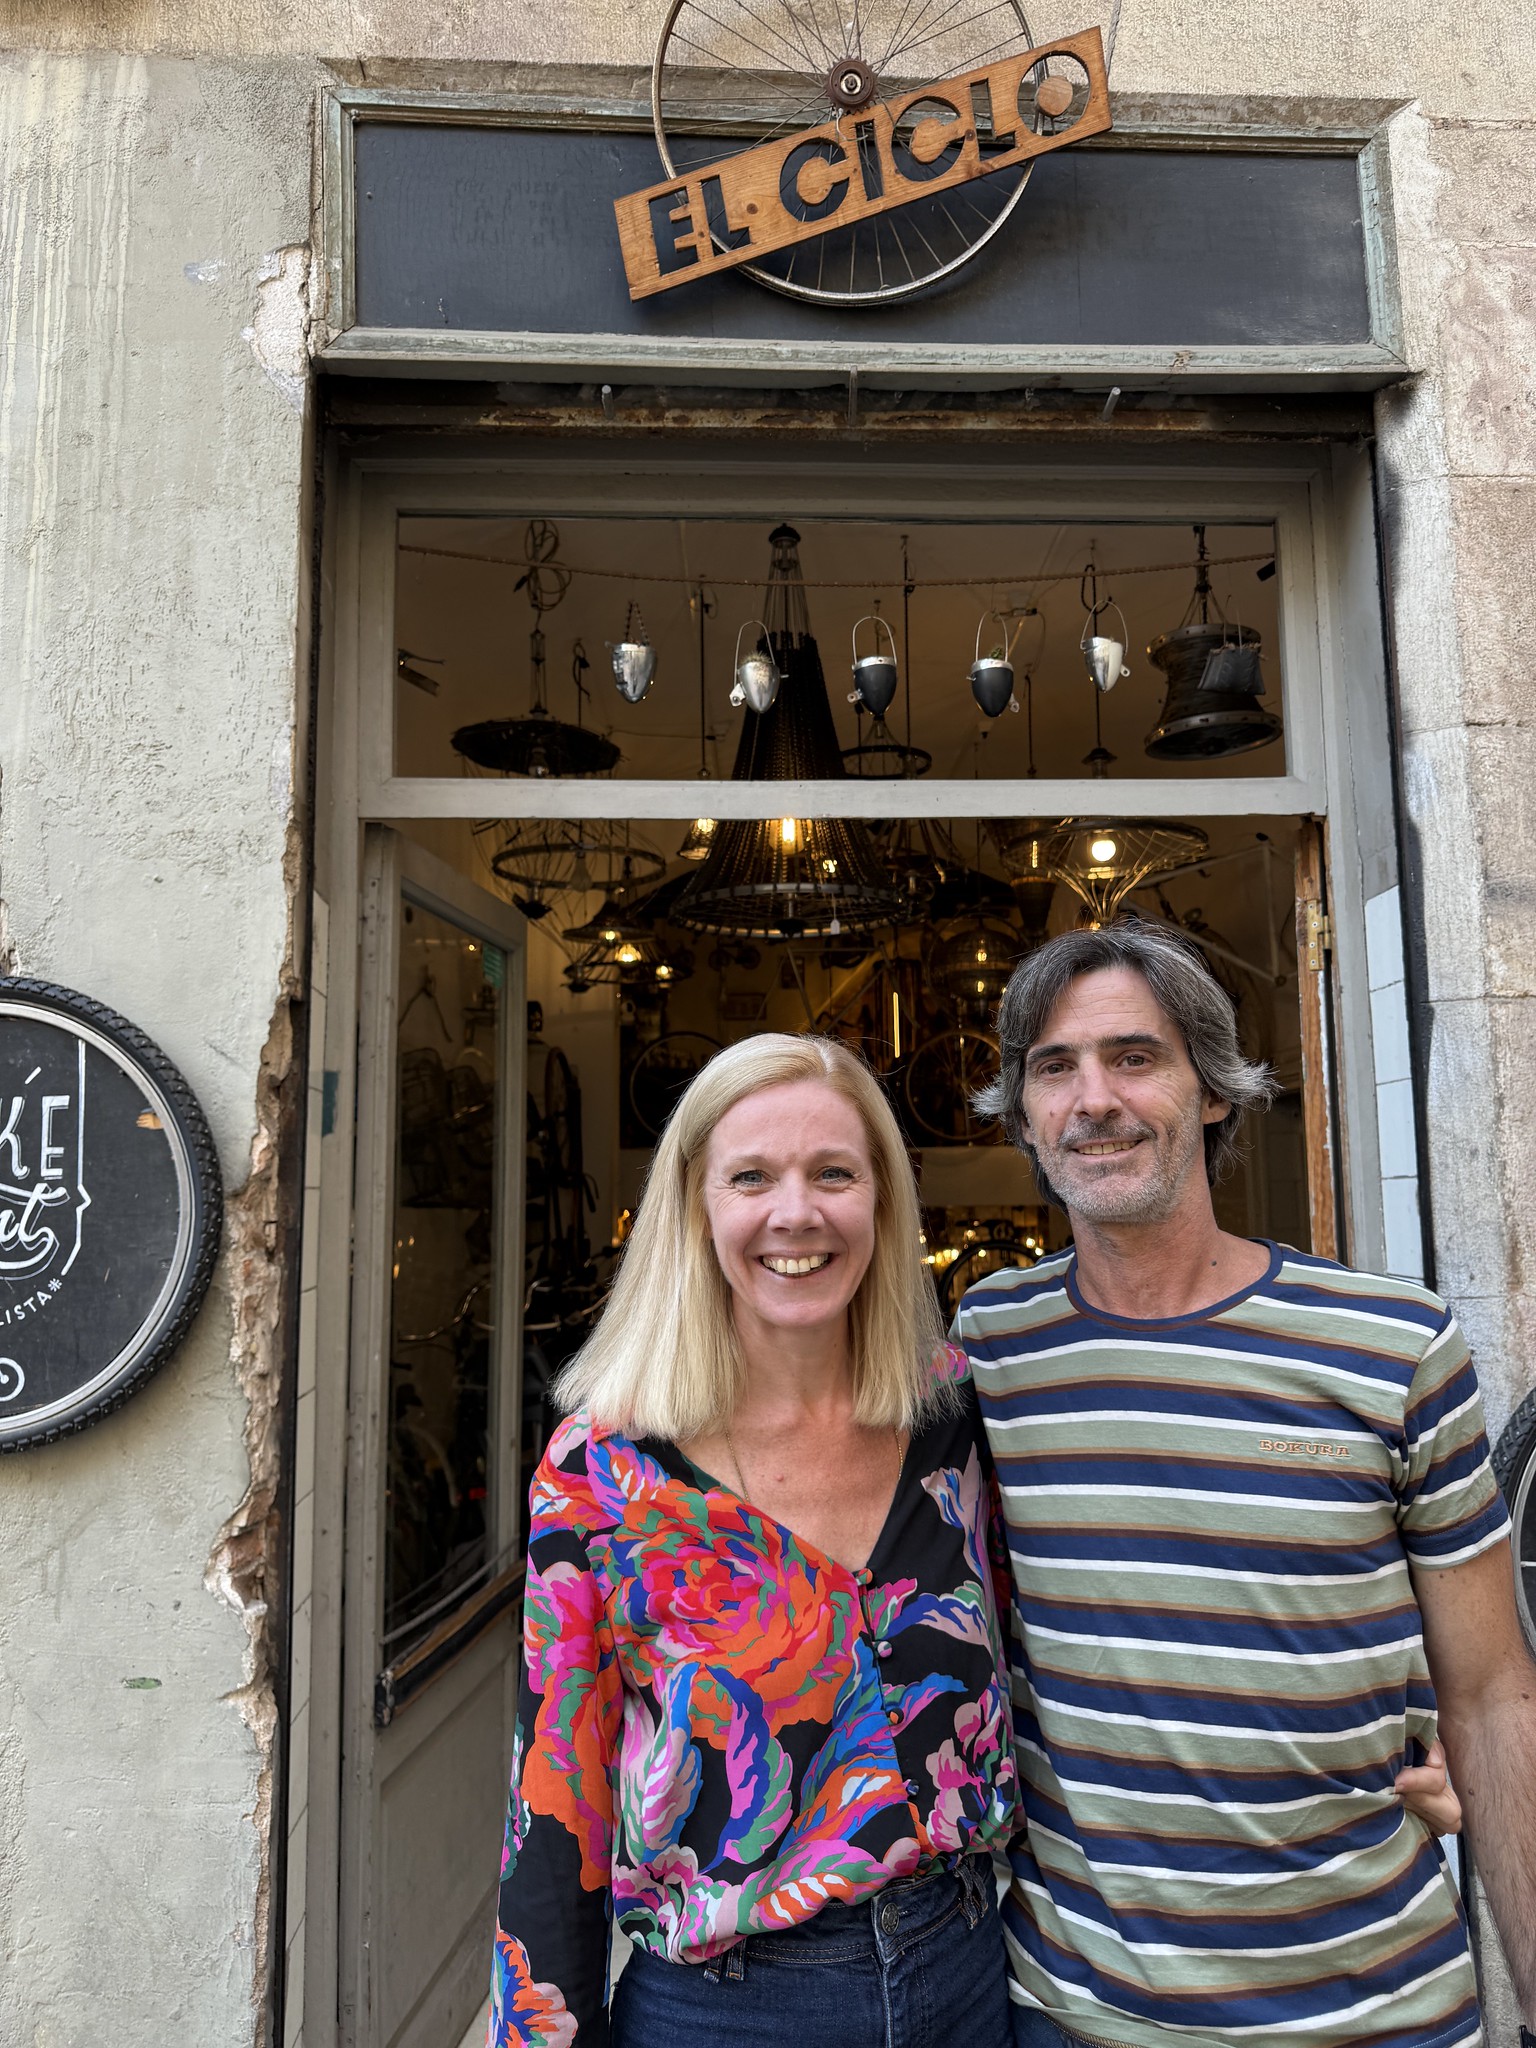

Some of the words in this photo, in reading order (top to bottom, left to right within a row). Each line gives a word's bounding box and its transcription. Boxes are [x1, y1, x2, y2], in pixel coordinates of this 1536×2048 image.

[648, 175, 751, 276] EL
[779, 50, 1091, 222] CICLO
[1259, 1439, 1350, 1458] BOKURA
